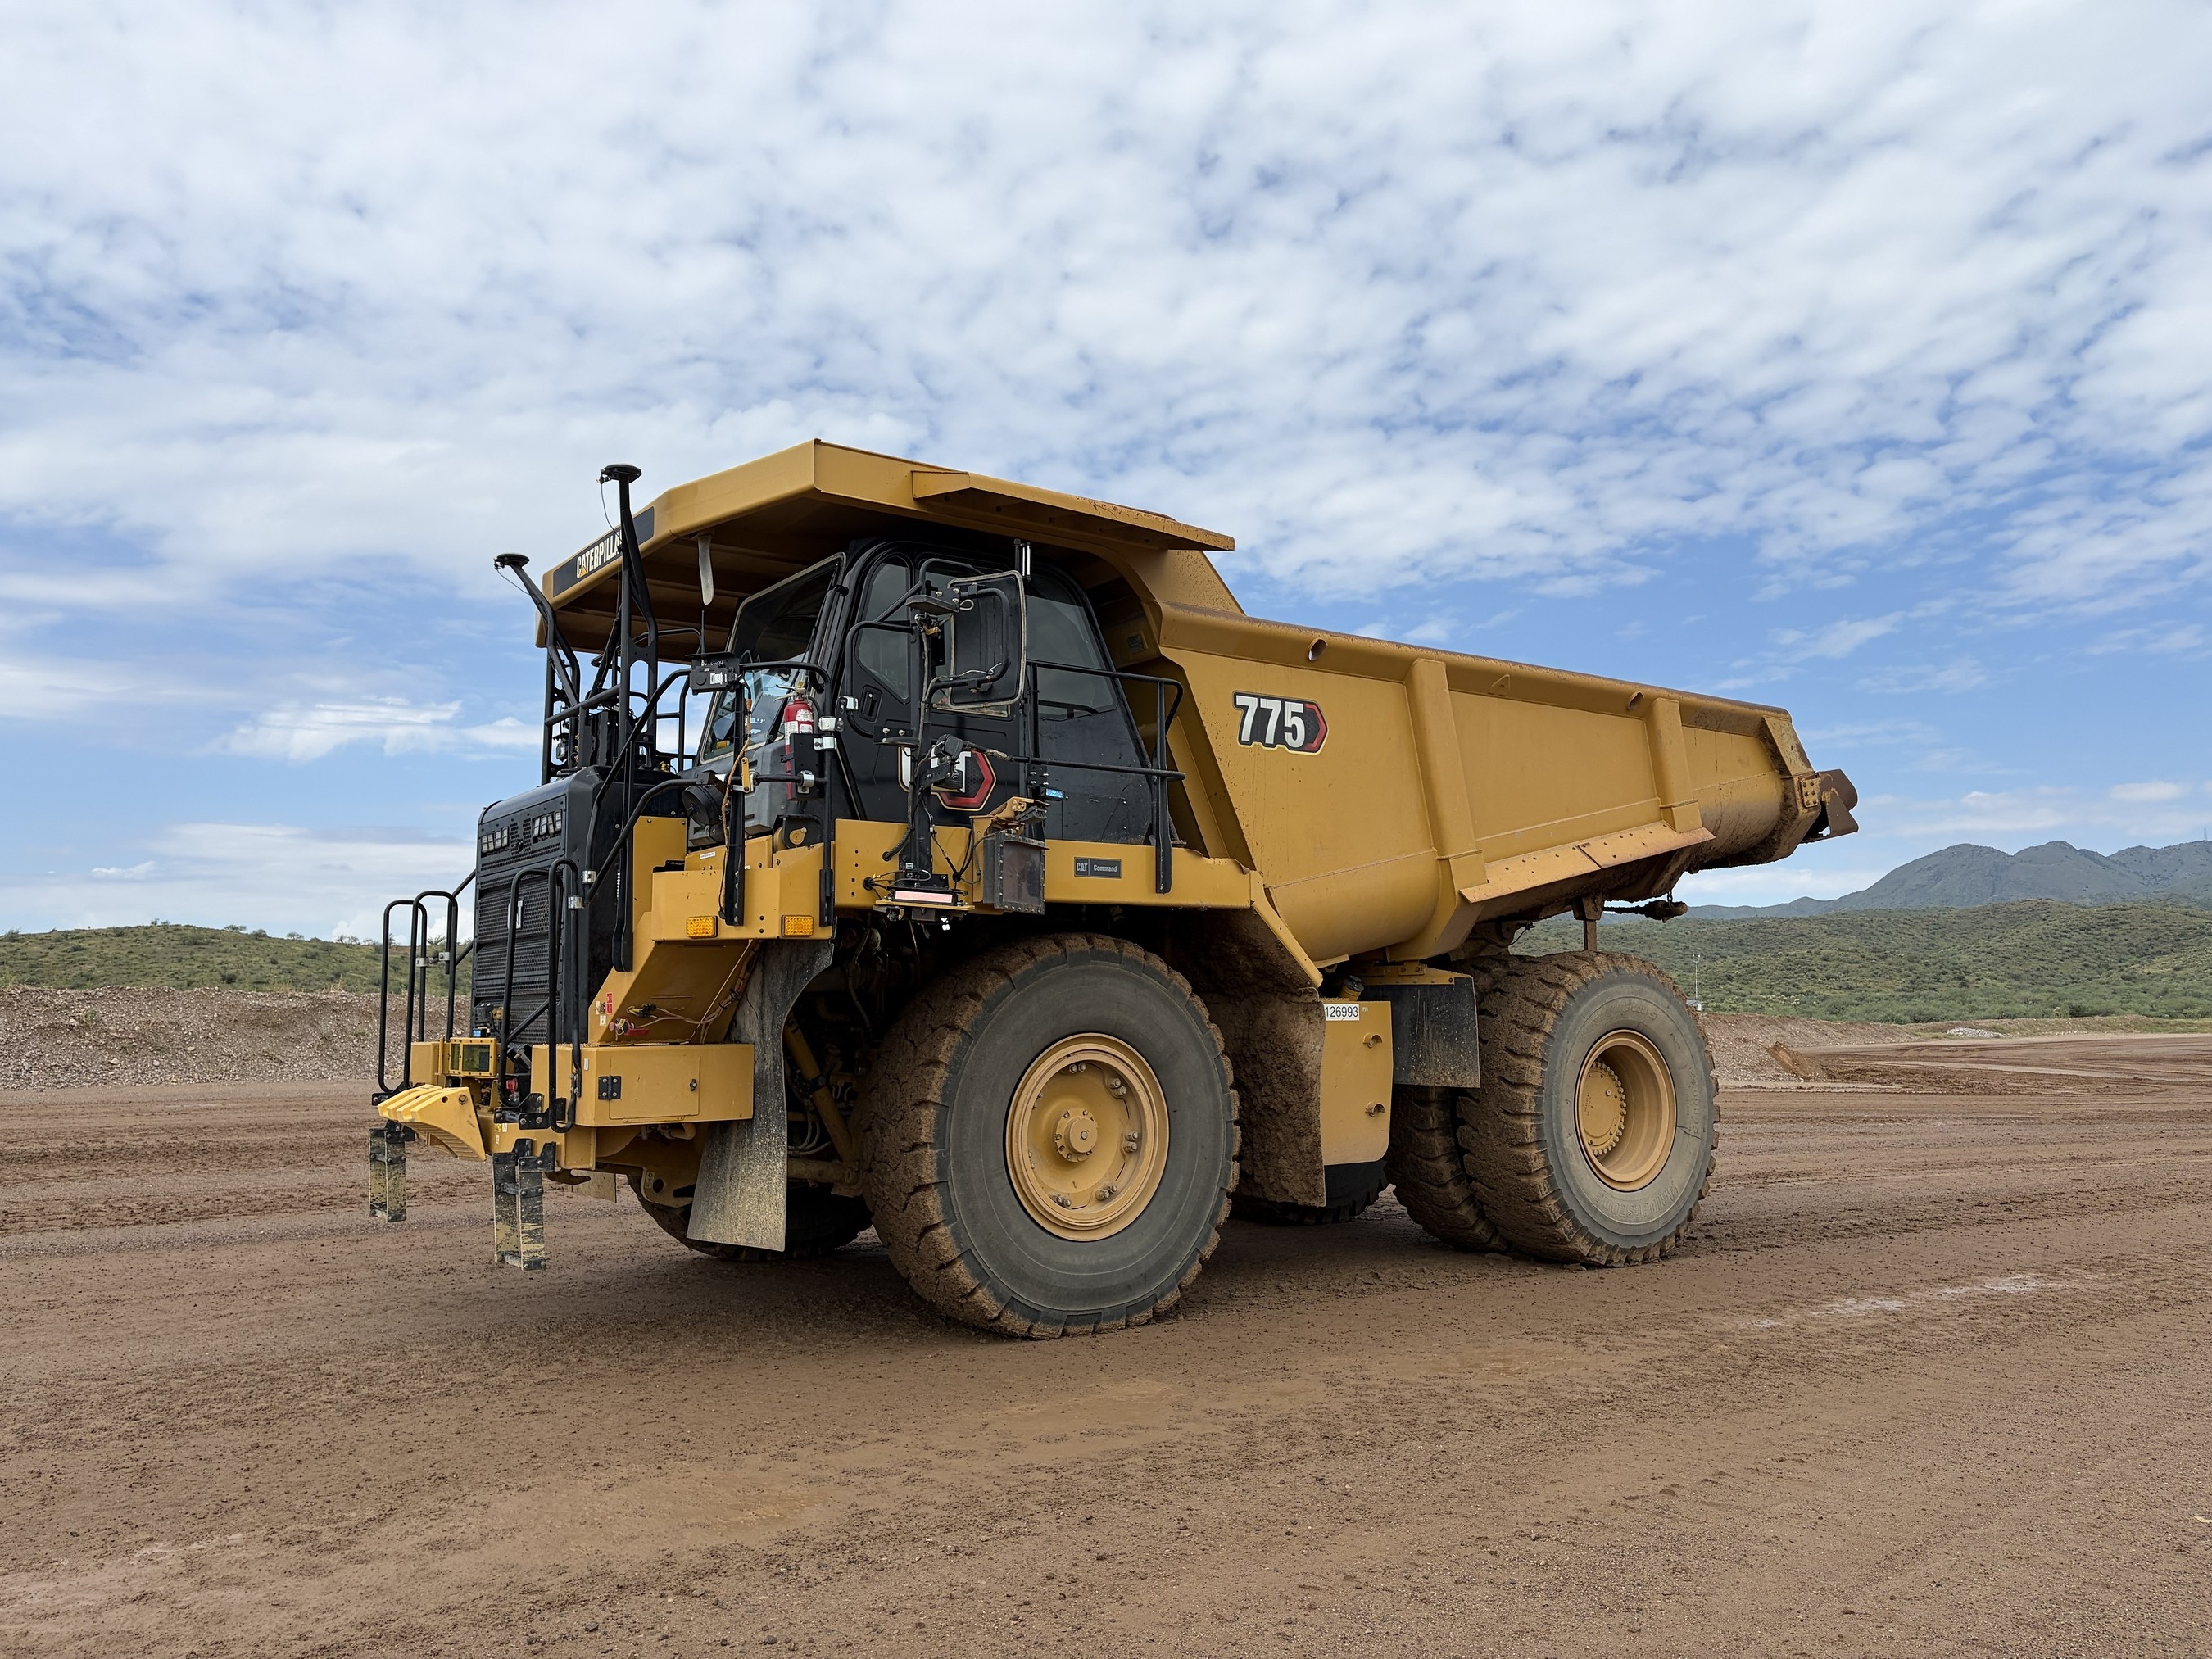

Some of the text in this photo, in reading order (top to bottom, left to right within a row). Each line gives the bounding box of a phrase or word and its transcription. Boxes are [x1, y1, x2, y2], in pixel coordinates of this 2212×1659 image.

[576, 529, 623, 579] CATERPILLA
[1235, 695, 1306, 748] 775
[1076, 863, 1117, 873] CAT Command
[1325, 1005, 1359, 1018] 126993
